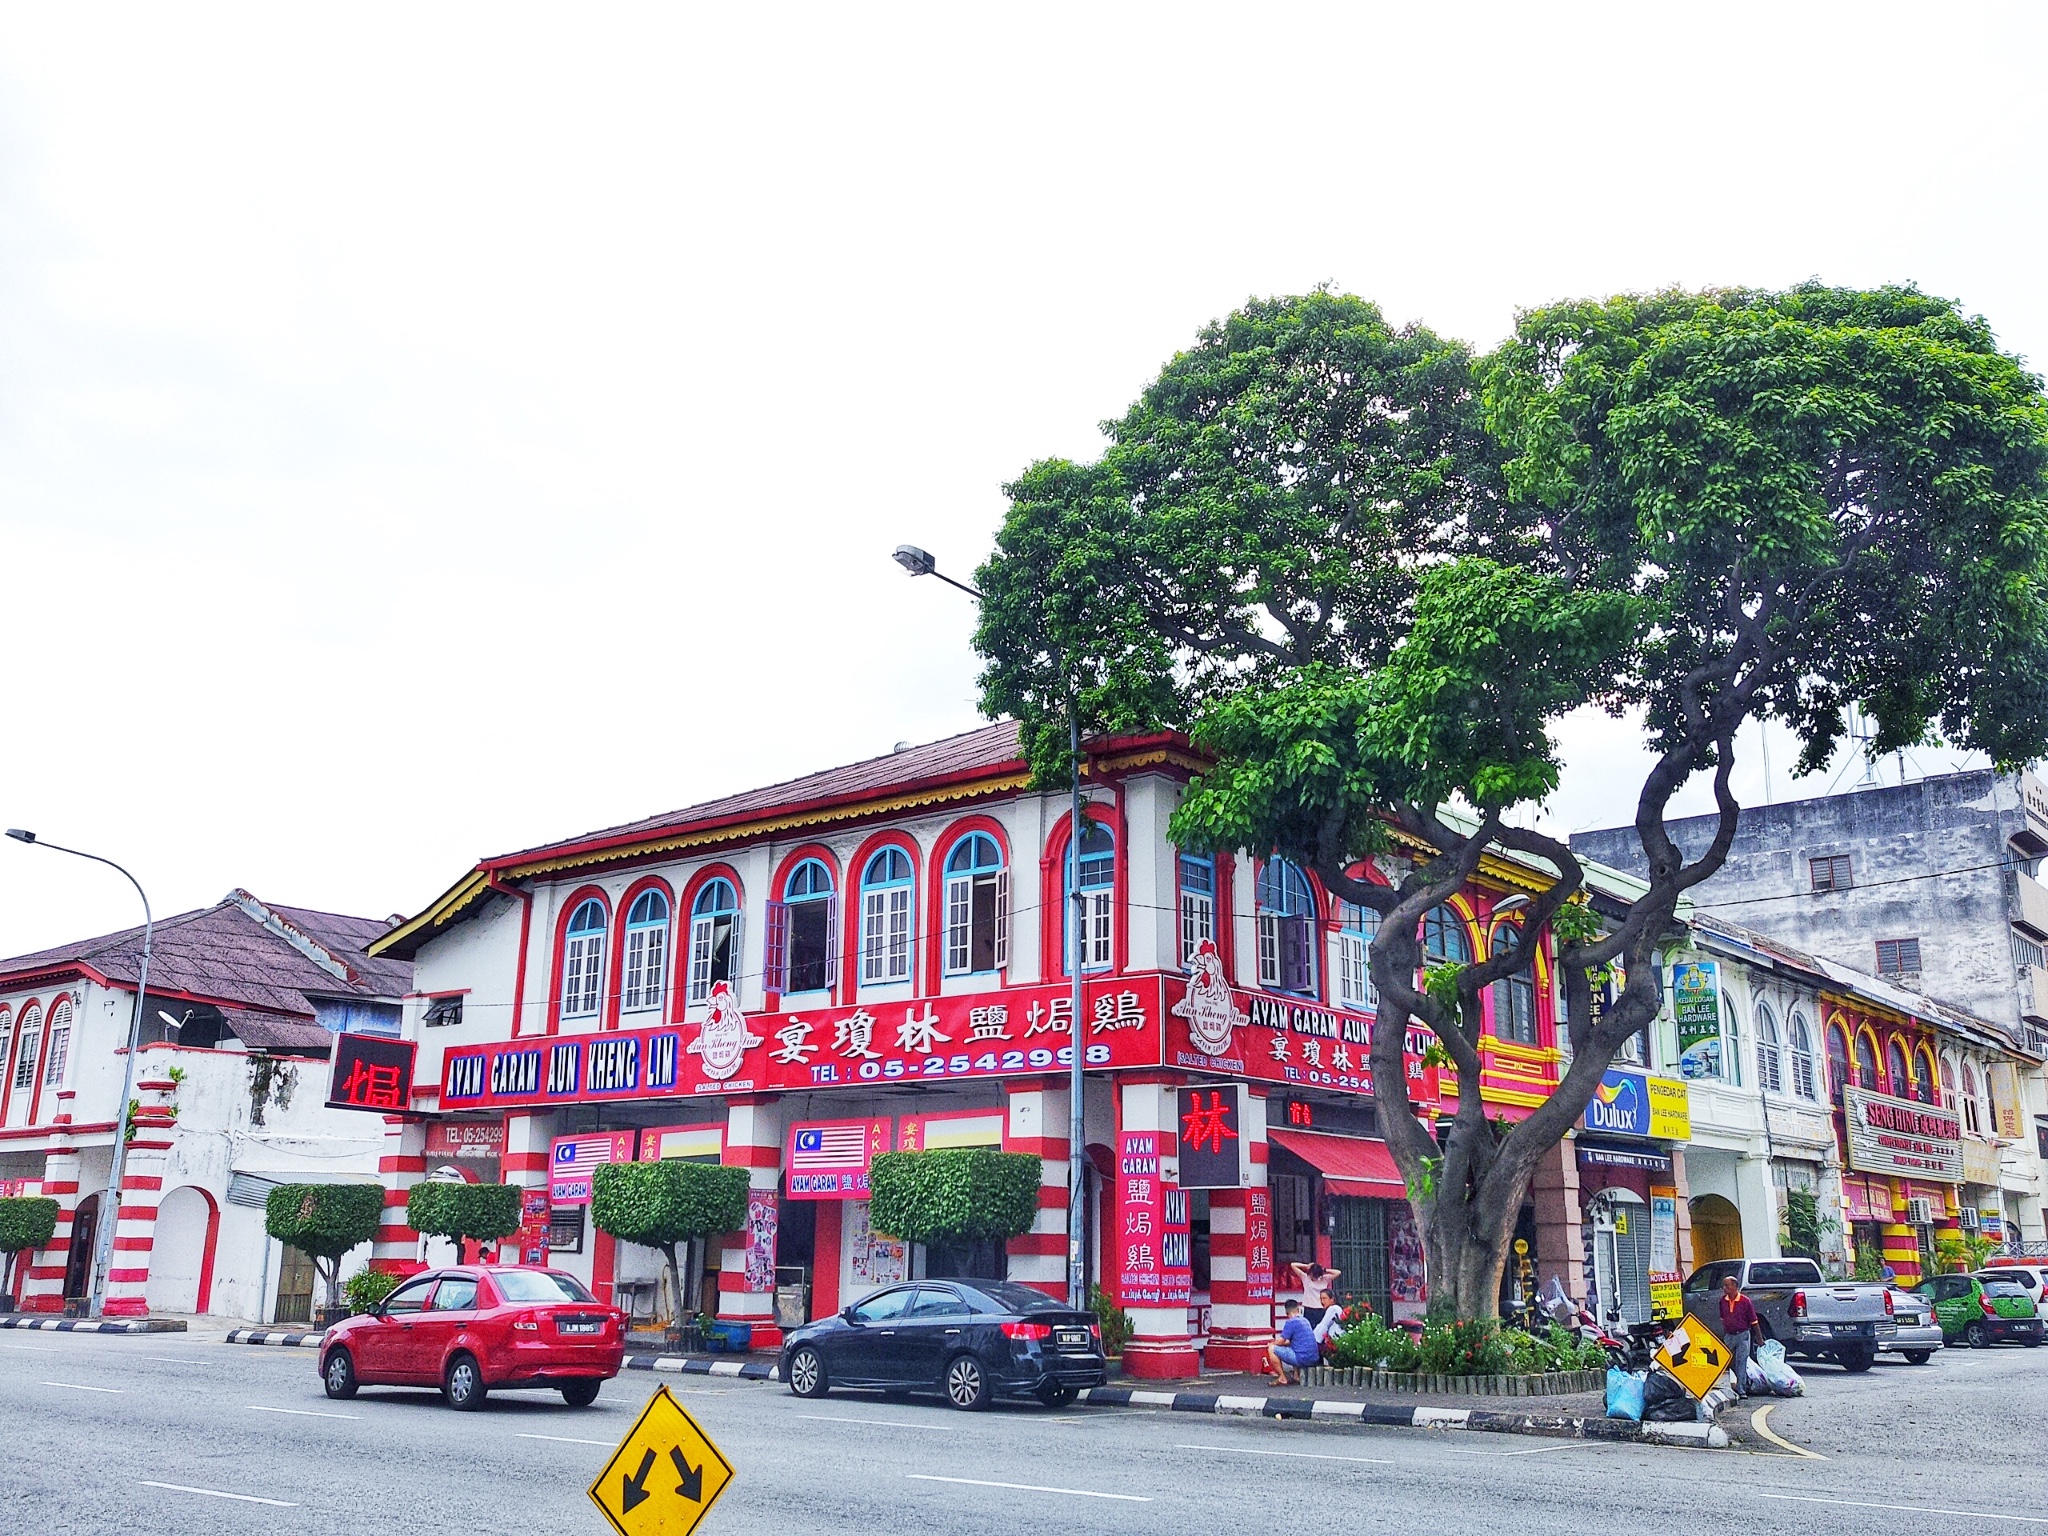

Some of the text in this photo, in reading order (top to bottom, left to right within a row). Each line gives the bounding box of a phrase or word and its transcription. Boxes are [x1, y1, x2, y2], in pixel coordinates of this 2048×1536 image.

[1251, 999, 1289, 1030] AYAM
[1293, 1007, 1338, 1039] GARAM
[1343, 1018, 1370, 1044] AUN
[1678, 1013, 1717, 1023] HARDWARE
[1682, 1004, 1710, 1014] BAN LEE
[446, 1035, 675, 1097] AYAM GARAM AUN KHENG LIM
[858, 1043, 1112, 1080] 05-2542998
[1181, 1090, 1239, 1154] 林
[1592, 1098, 1634, 1130] Dulux
[1125, 1137, 1154, 1155] AYAM
[1121, 1157, 1157, 1174] GARAM
[552, 1181, 588, 1200] AYAM GARAM
[790, 1174, 811, 1193] AYAM
[811, 1173, 838, 1192] GARAM
[1165, 1189, 1186, 1225] AYAM
[1162, 1232, 1189, 1267] GARAM
[1650, 1273, 1668, 1282] NOTICE
